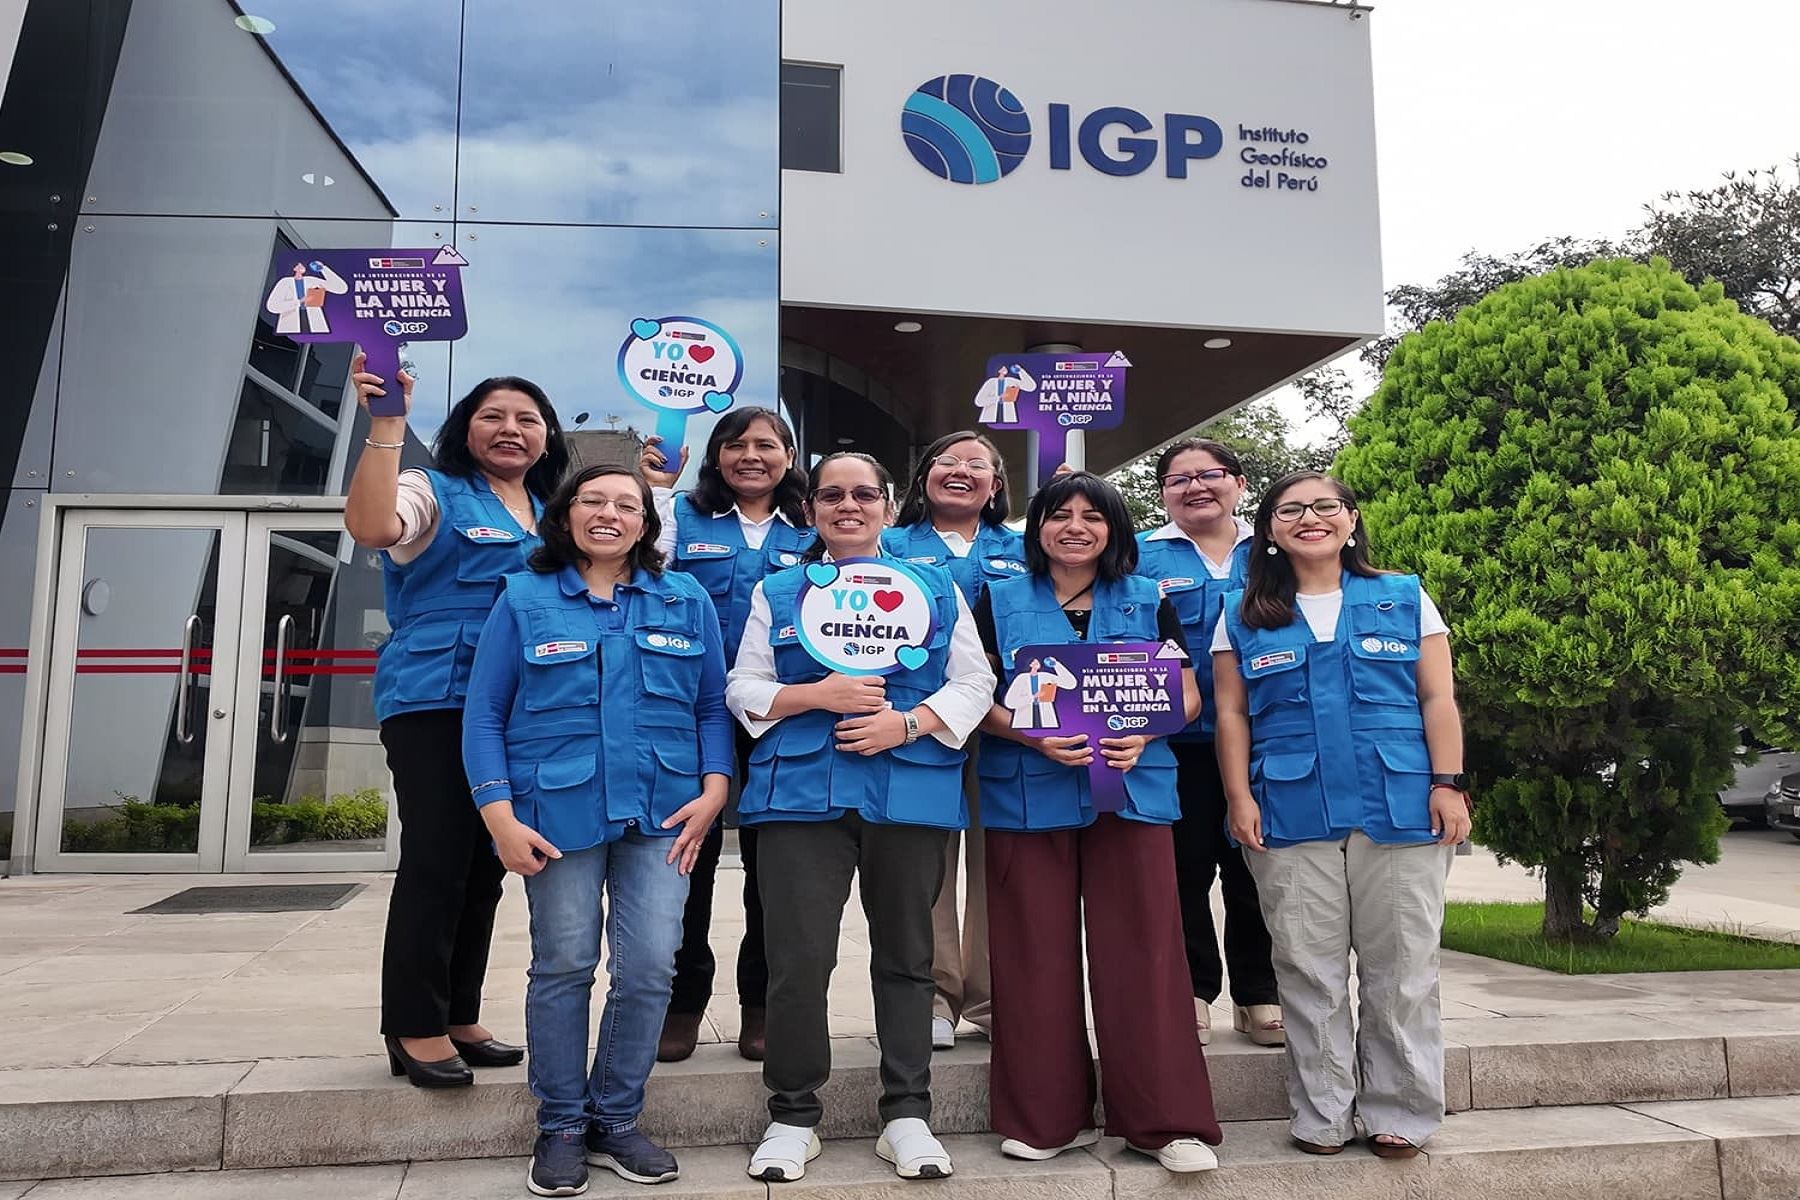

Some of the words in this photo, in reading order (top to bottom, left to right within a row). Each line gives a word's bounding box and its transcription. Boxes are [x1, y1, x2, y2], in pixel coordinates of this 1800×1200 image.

[1049, 103, 1223, 179] IGP
[1238, 124, 1309, 144] Instituto
[1240, 147, 1328, 169] Geofísico
[1241, 169, 1270, 188] del
[1277, 172, 1318, 192] Perú
[354, 280, 426, 292] MUJER
[432, 280, 447, 292] Y
[354, 295, 384, 308] LA
[390, 291, 450, 308] NIÑA
[356, 309, 374, 318] EN
[378, 309, 396, 318] LA
[400, 308, 452, 317] CIENCIA
[403, 323, 427, 332] IGP
[652, 341, 684, 361] YO
[671, 362, 689, 370] LA
[640, 368, 717, 387] CIENCIA
[1041, 380, 1095, 390] MUJER
[1101, 379, 1113, 390] Y
[673, 389, 695, 398] IGP
[1039, 392, 1061, 403] LA
[1066, 389, 1112, 403] NIÑA
[1072, 403, 1112, 411] CIENCIA
[1072, 415, 1091, 423] IGP
[831, 589, 868, 611] YO
[820, 622, 910, 640] CIENCIA
[668, 636, 690, 650] IGP
[1383, 640, 1408, 654] IGP
[862, 646, 885, 655] IGP
[1083, 674, 1148, 687] MUJER
[1154, 674, 1168, 687] Y
[1082, 690, 1108, 703] LA
[1115, 686, 1170, 702] NIÑA
[1083, 704, 1099, 712] EN
[1103, 704, 1119, 712] LA
[1122, 703, 1171, 712] CIENCIA
[1125, 718, 1147, 727] IGP
